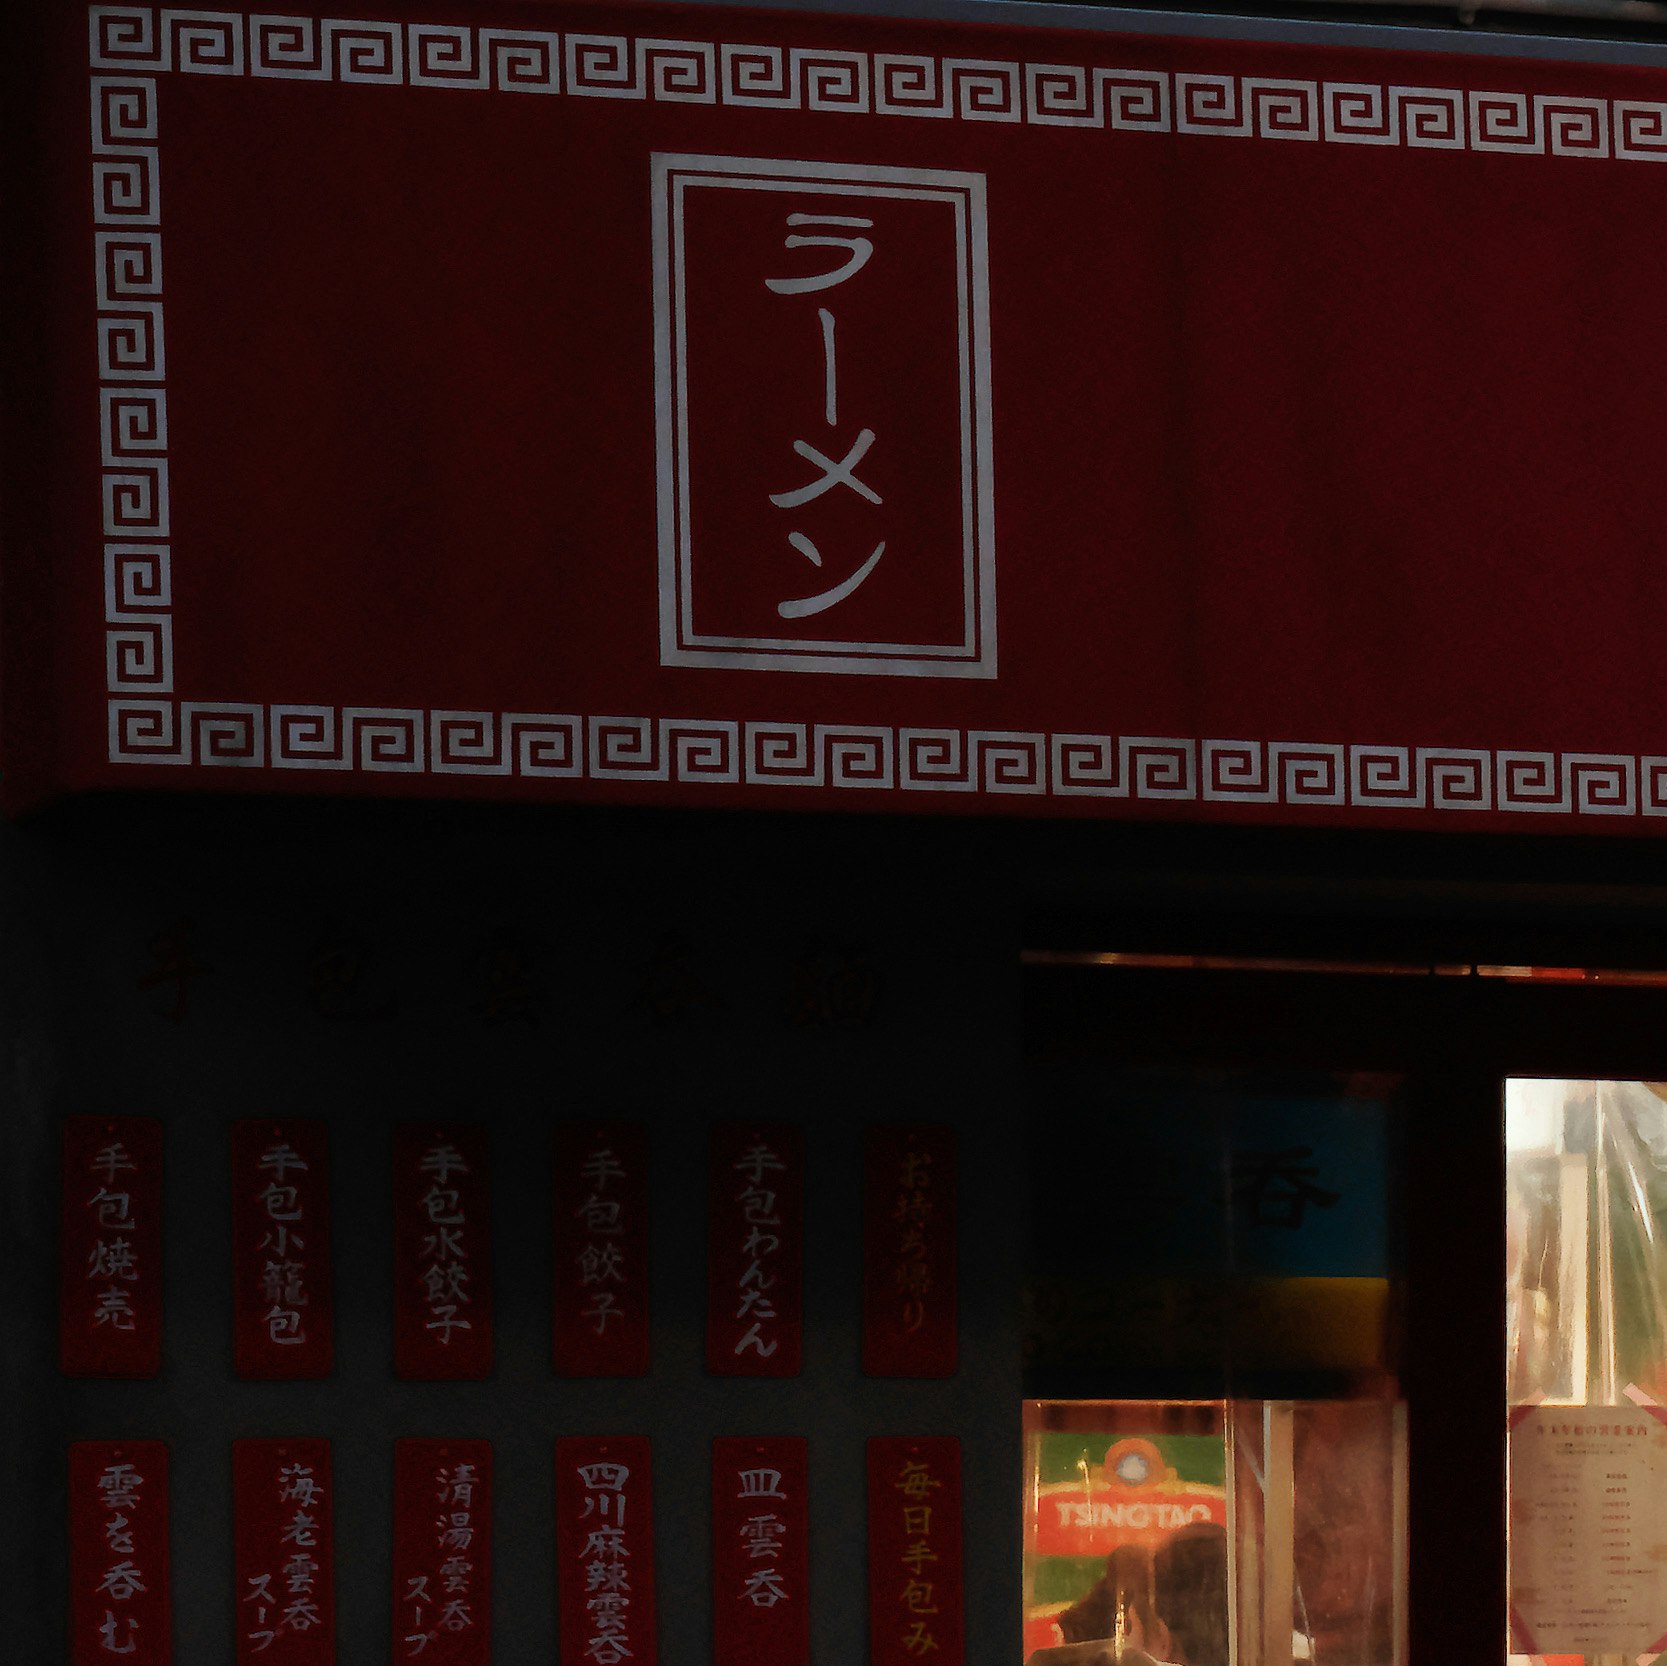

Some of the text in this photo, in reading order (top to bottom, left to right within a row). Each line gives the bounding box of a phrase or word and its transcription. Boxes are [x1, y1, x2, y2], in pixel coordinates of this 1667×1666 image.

[764, 211, 886, 620] ラーメン
[88, 1142, 138, 1331] 手包焼売
[257, 1144, 310, 1346] 手包小籠包
[421, 1148, 472, 1345] 手包水餃子
[578, 1149, 625, 1335] 手包餃子
[731, 1145, 787, 1359] 手包わんたん
[97, 1463, 146, 1654] 雲を呑む
[248, 1573, 275, 1650] スープ
[279, 1462, 324, 1630] 海老雲呑
[404, 1575, 433, 1655] スープ
[435, 1463, 477, 1630] 清湯雲呑
[576, 1462, 632, 1665] 四川麻辣雲呑
[737, 1468, 788, 1608] 皿雲呑
[895, 1460, 941, 1655] 毎日手包み
